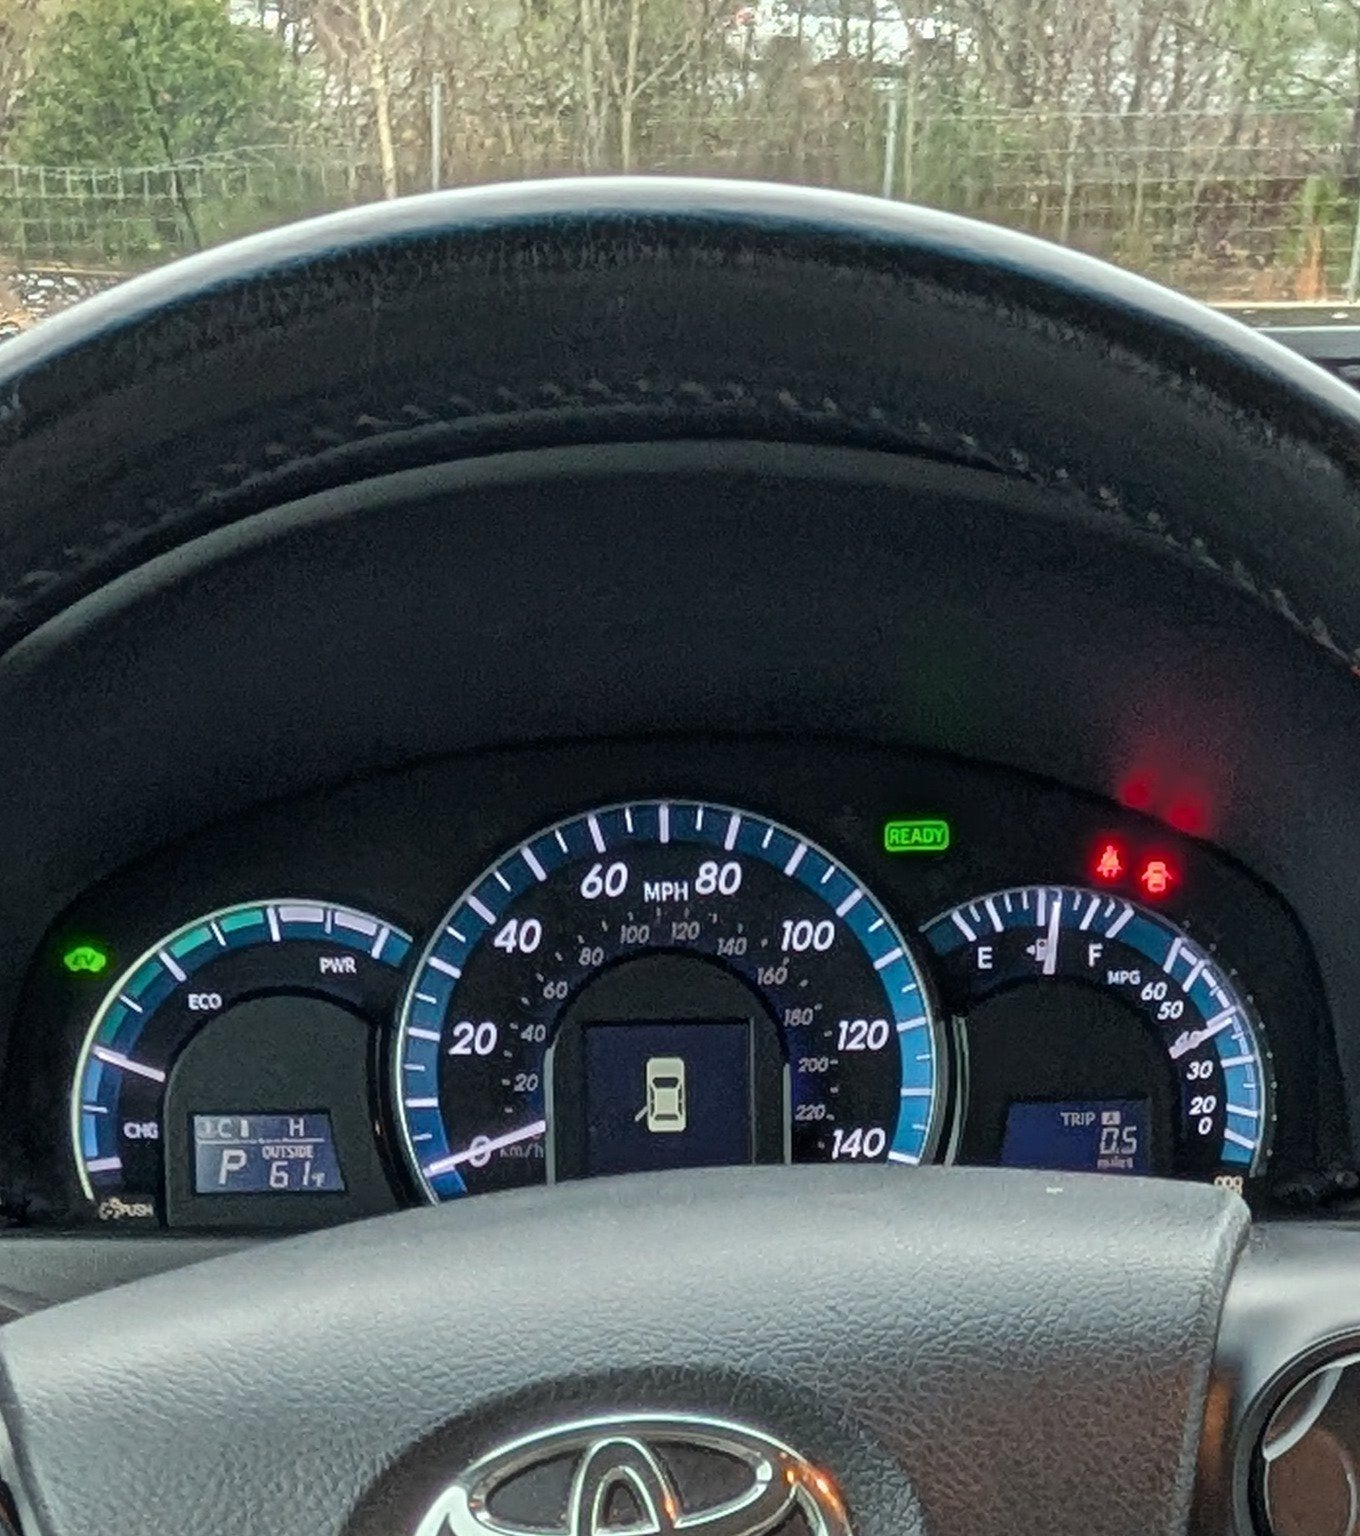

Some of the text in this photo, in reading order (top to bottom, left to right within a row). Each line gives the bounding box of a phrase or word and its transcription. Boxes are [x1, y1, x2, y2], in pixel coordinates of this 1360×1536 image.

[890, 826, 944, 845] READY
[580, 862, 628, 898] 60
[695, 861, 741, 896] 80
[643, 882, 689, 902] MPH
[494, 918, 542, 953] 40
[620, 924, 650, 945] 100
[671, 921, 700, 941] 120
[781, 919, 836, 951] 100
[717, 937, 747, 956] 140
[1089, 943, 1103, 967] F
[319, 956, 357, 975] PWR
[578, 948, 604, 966] 80
[977, 946, 993, 969] E
[757, 966, 788, 985] 160
[1107, 970, 1141, 985] MPG
[543, 981, 568, 999] 60
[1141, 981, 1168, 1001] 60
[188, 993, 222, 1011] ECO
[1157, 1000, 1184, 1020] 50
[783, 1007, 814, 1027] 180
[448, 1022, 497, 1056] 20
[521, 1025, 546, 1042] 40
[838, 1019, 890, 1050] 120
[798, 1057, 829, 1073] 200
[1186, 1060, 1214, 1080] 30
[513, 1074, 539, 1091] 20
[795, 1104, 826, 1121] 220
[1188, 1095, 1217, 1116] 20
[290, 1117, 305, 1137] H
[1060, 1111, 1096, 1127] TRIP
[1198, 1116, 1213, 1136] 0
[123, 1121, 159, 1140] CHG
[261, 1145, 315, 1160] OUTSIDE
[499, 1138, 545, 1159] km/h
[831, 1127, 886, 1159] 140
[218, 1149, 248, 1185] P
[1097, 1155, 1134, 1170] miles
[121, 1202, 155, 1218] PUSH
